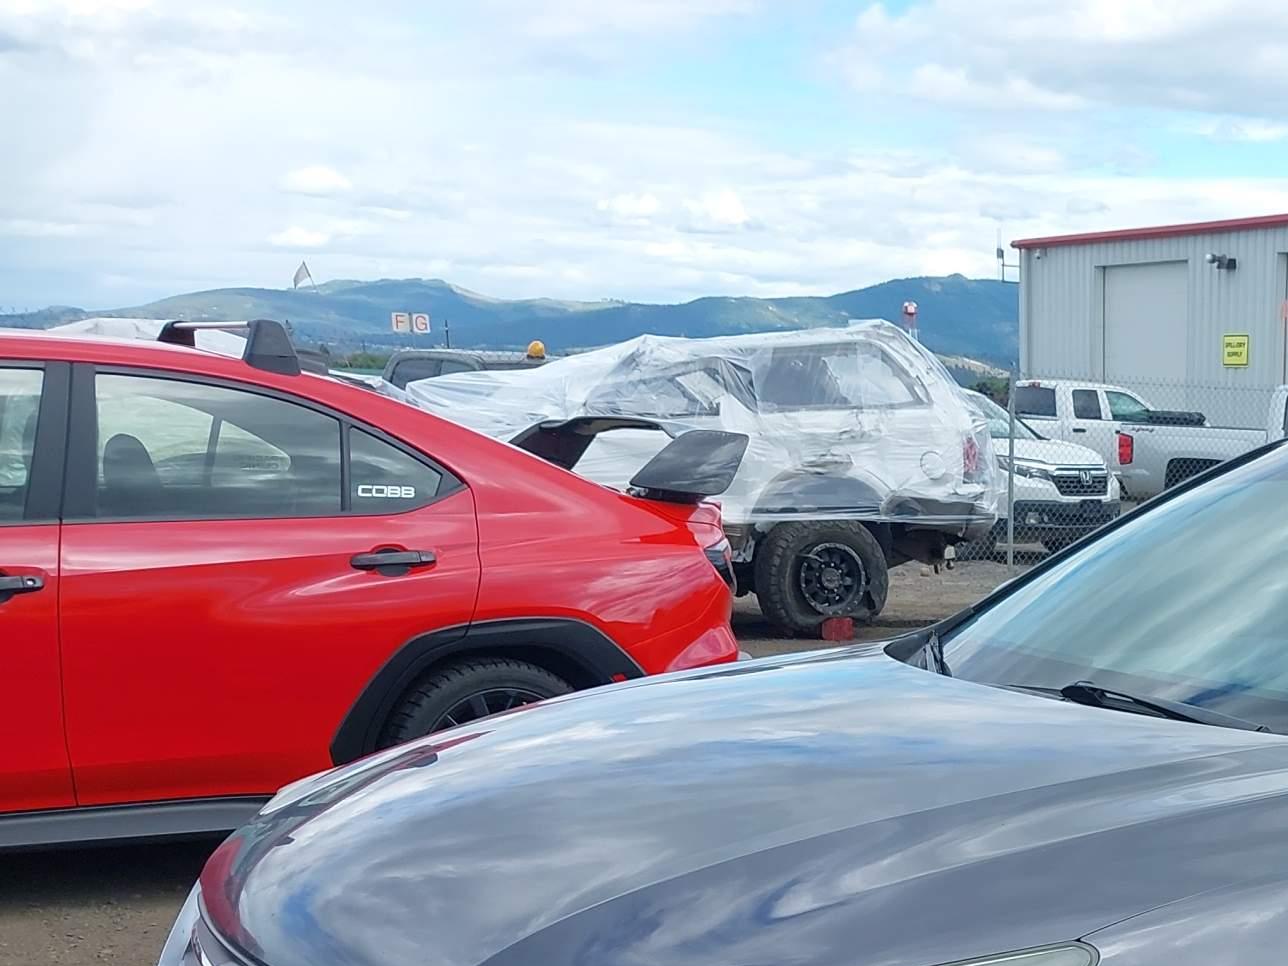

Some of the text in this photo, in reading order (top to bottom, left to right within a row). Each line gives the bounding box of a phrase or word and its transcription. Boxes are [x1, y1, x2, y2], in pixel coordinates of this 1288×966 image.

[395, 314, 406, 329] F
[415, 315, 428, 331] G
[357, 484, 416, 499] COBB
